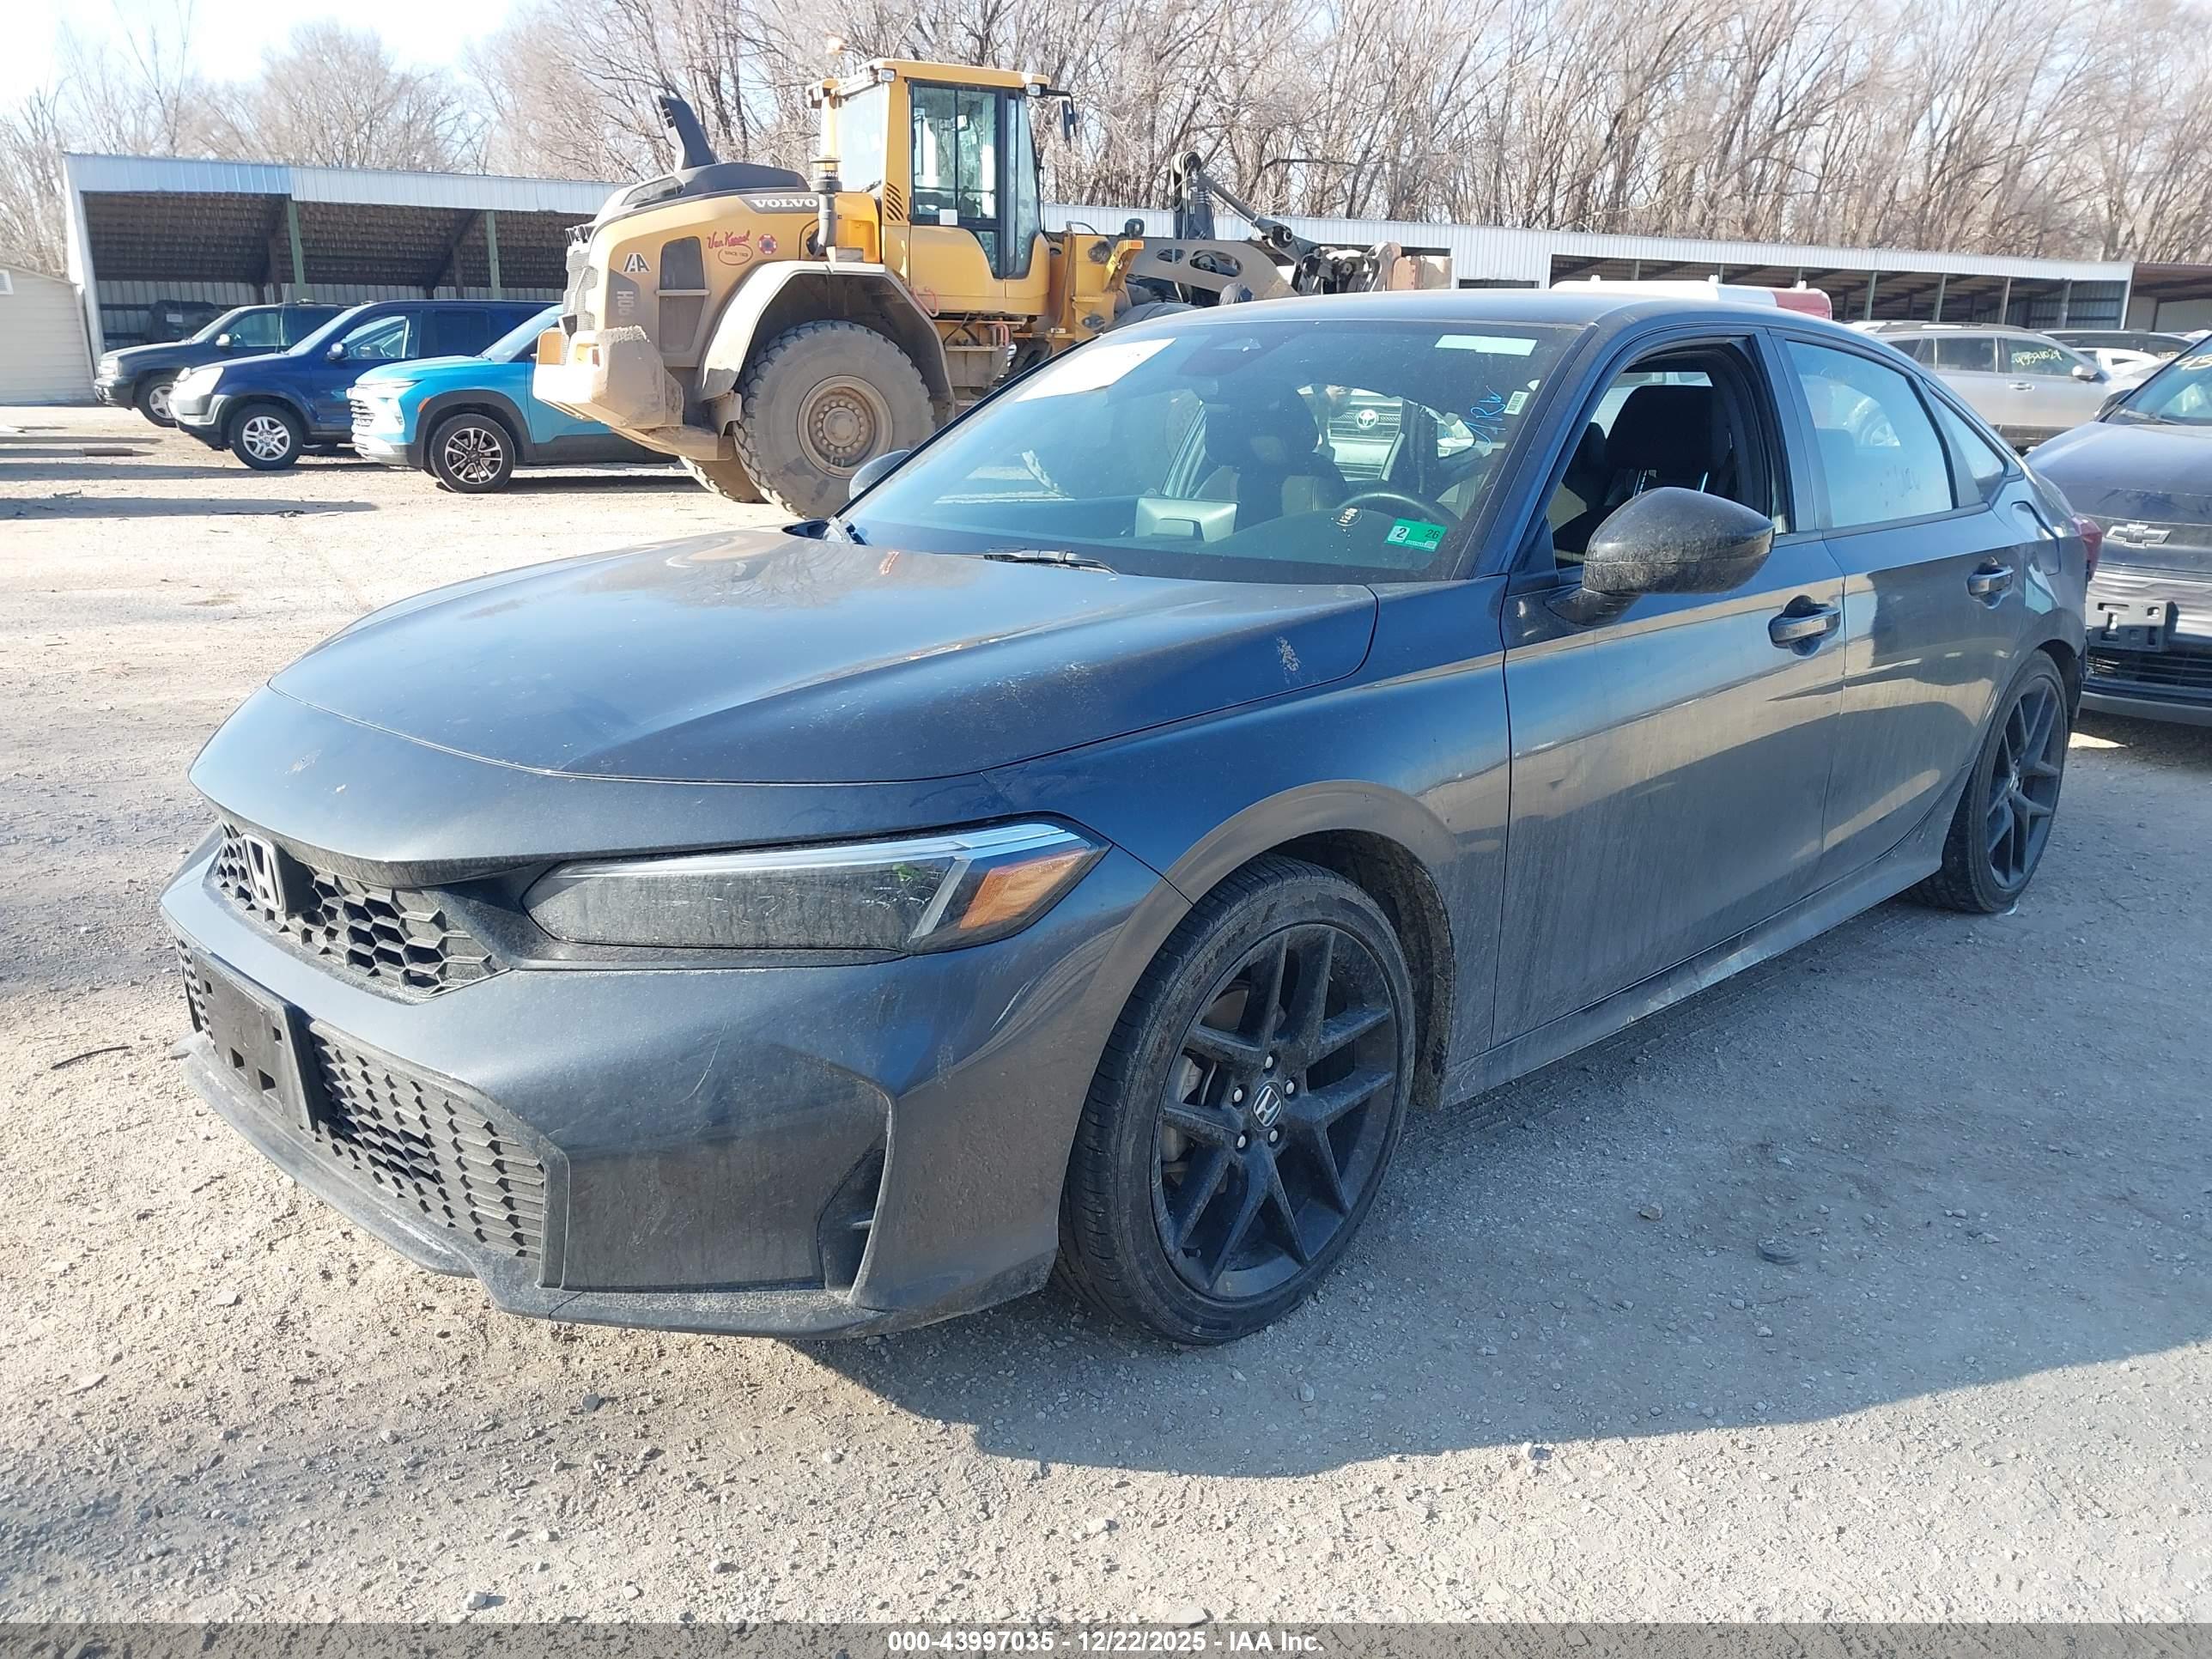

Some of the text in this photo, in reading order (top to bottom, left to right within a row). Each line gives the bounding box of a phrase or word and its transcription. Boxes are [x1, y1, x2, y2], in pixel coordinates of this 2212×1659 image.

[750, 198, 818, 208] VOLVO
[1396, 527, 1441, 539] 2 26
